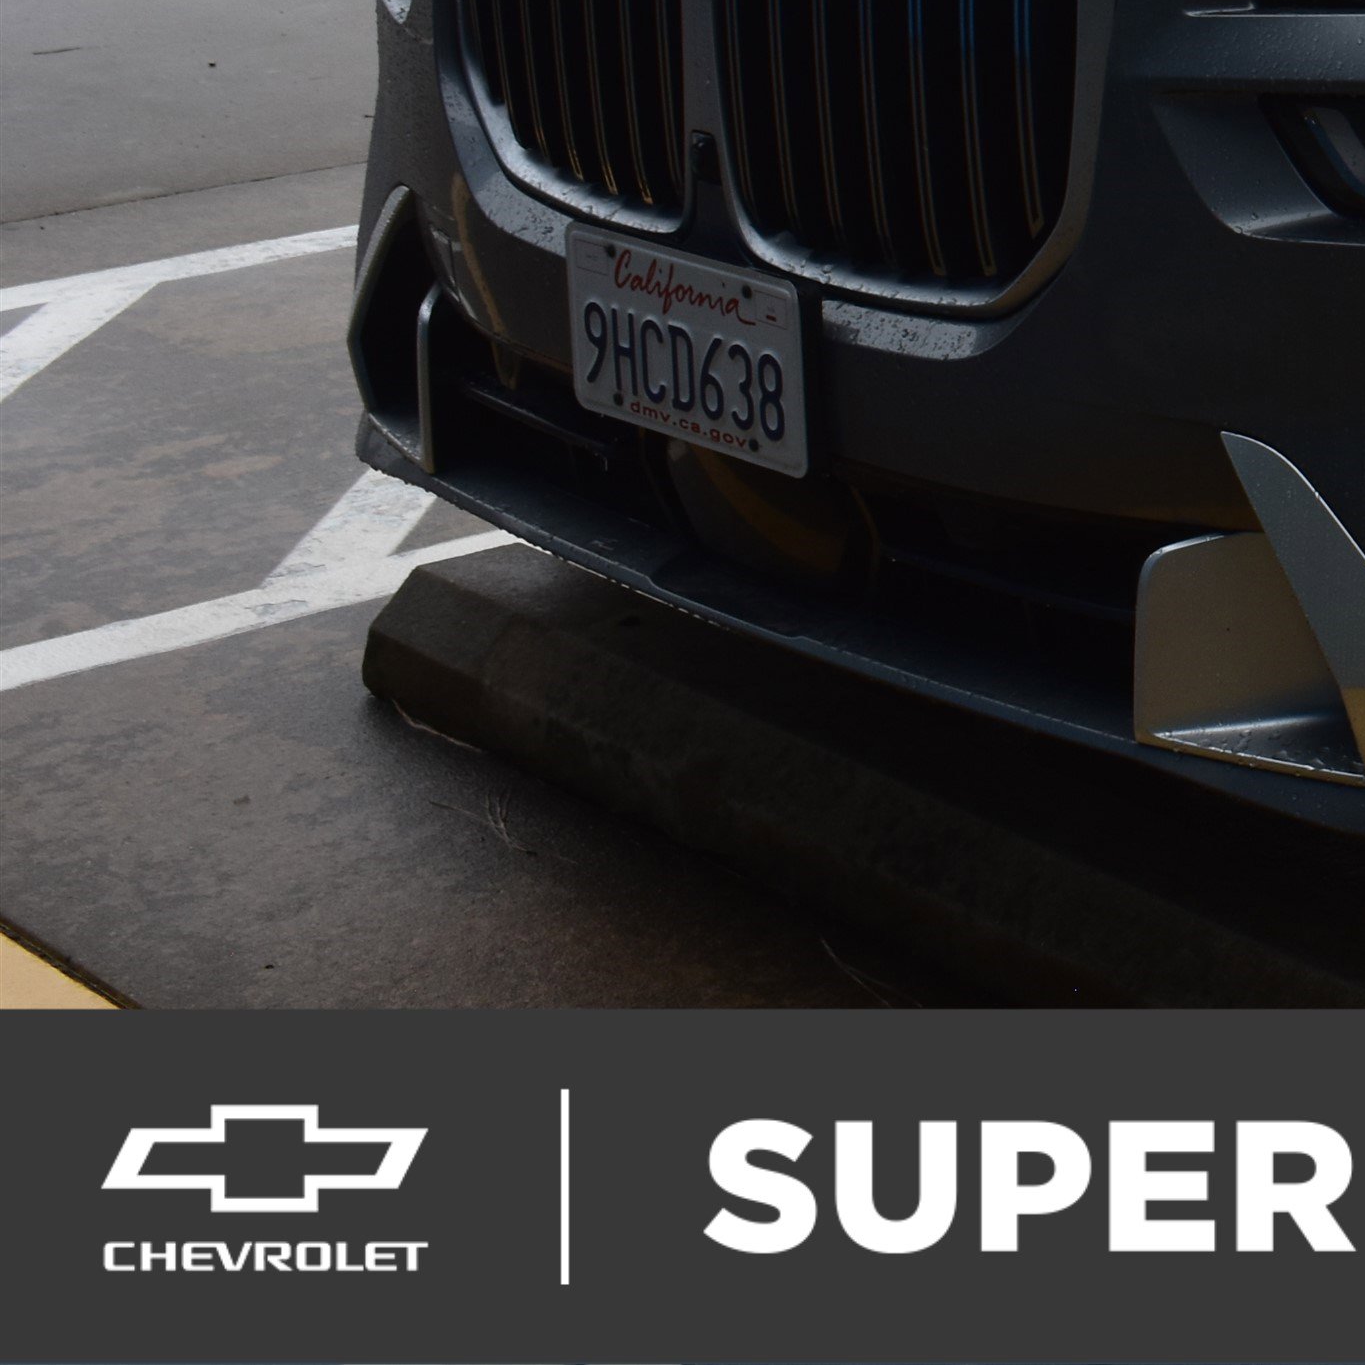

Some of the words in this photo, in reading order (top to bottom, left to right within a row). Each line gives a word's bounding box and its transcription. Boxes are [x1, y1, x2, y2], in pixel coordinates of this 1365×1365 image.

[614, 249, 756, 325] California
[584, 301, 785, 442] 9HCD638
[629, 400, 748, 449] dmv.ca.gov
